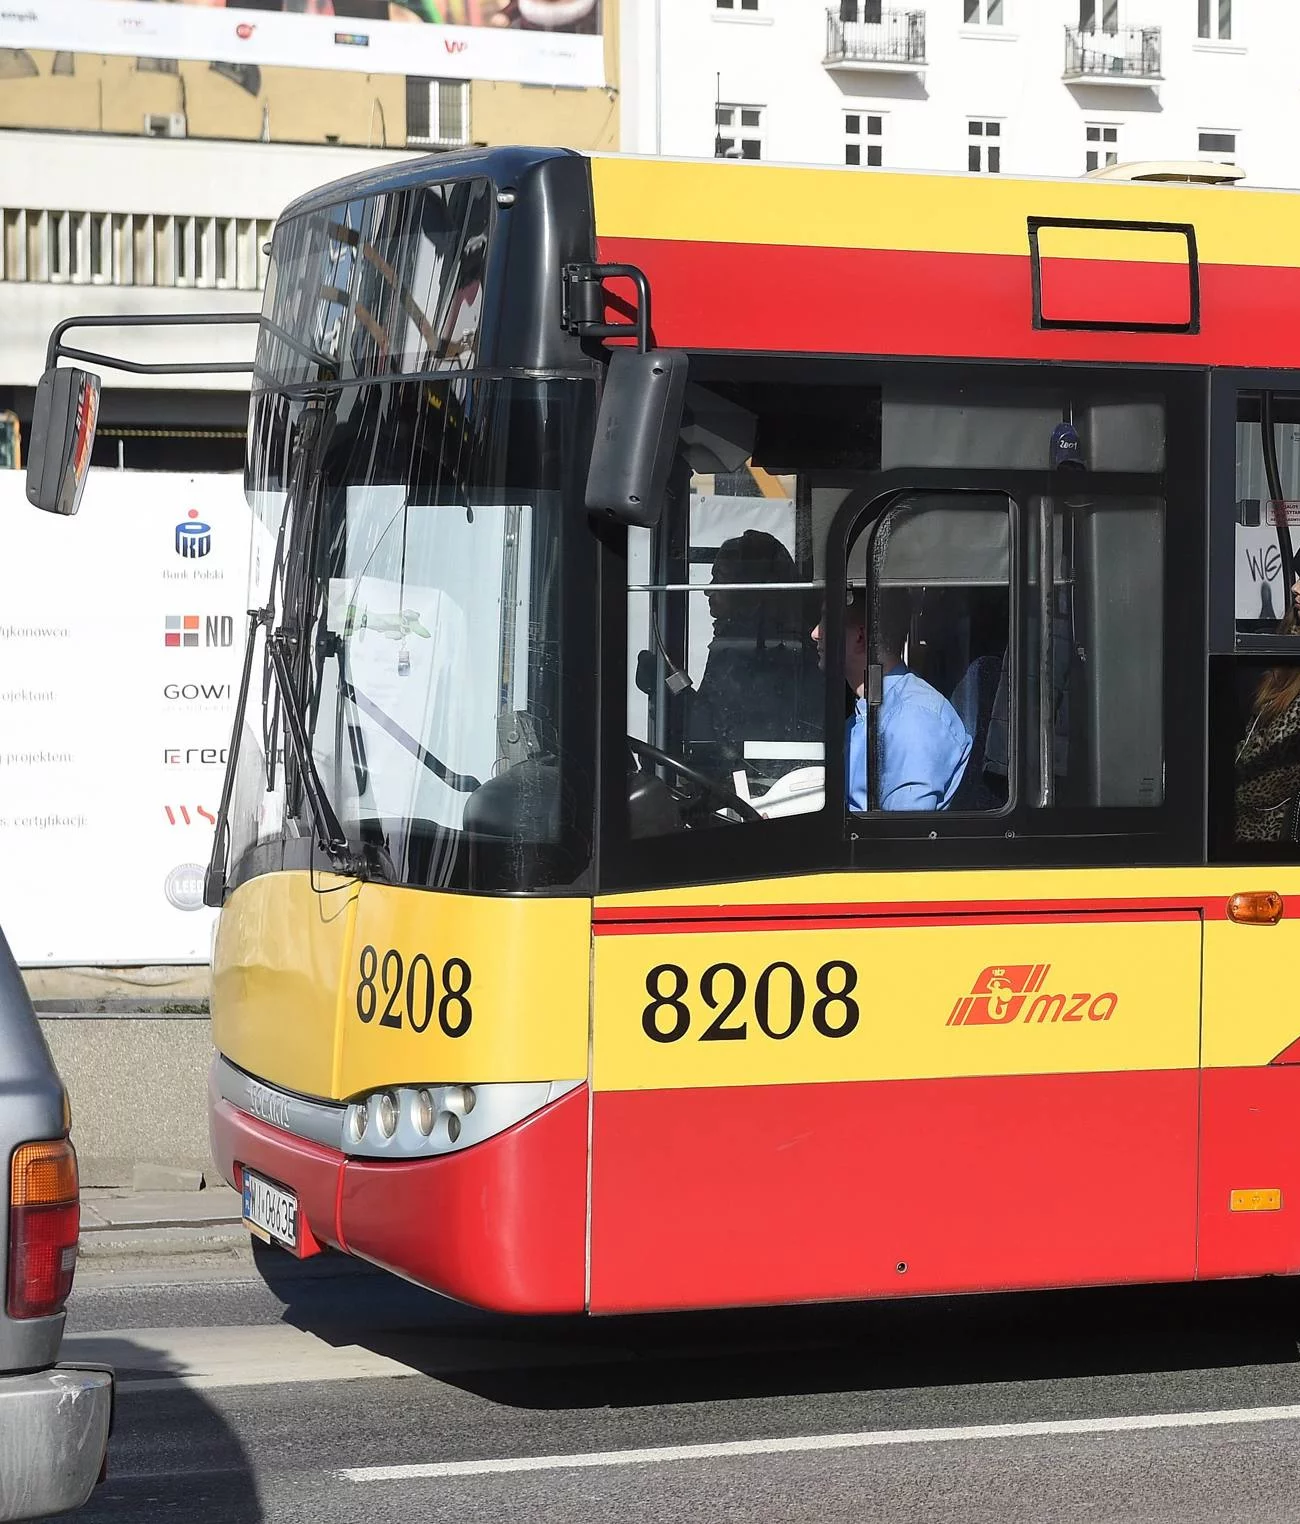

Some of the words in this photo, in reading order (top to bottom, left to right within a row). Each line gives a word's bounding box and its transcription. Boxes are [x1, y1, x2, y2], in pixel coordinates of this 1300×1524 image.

[356, 944, 473, 1038] 8208
[642, 960, 860, 1043] 8208
[1024, 992, 1119, 1024] mza
